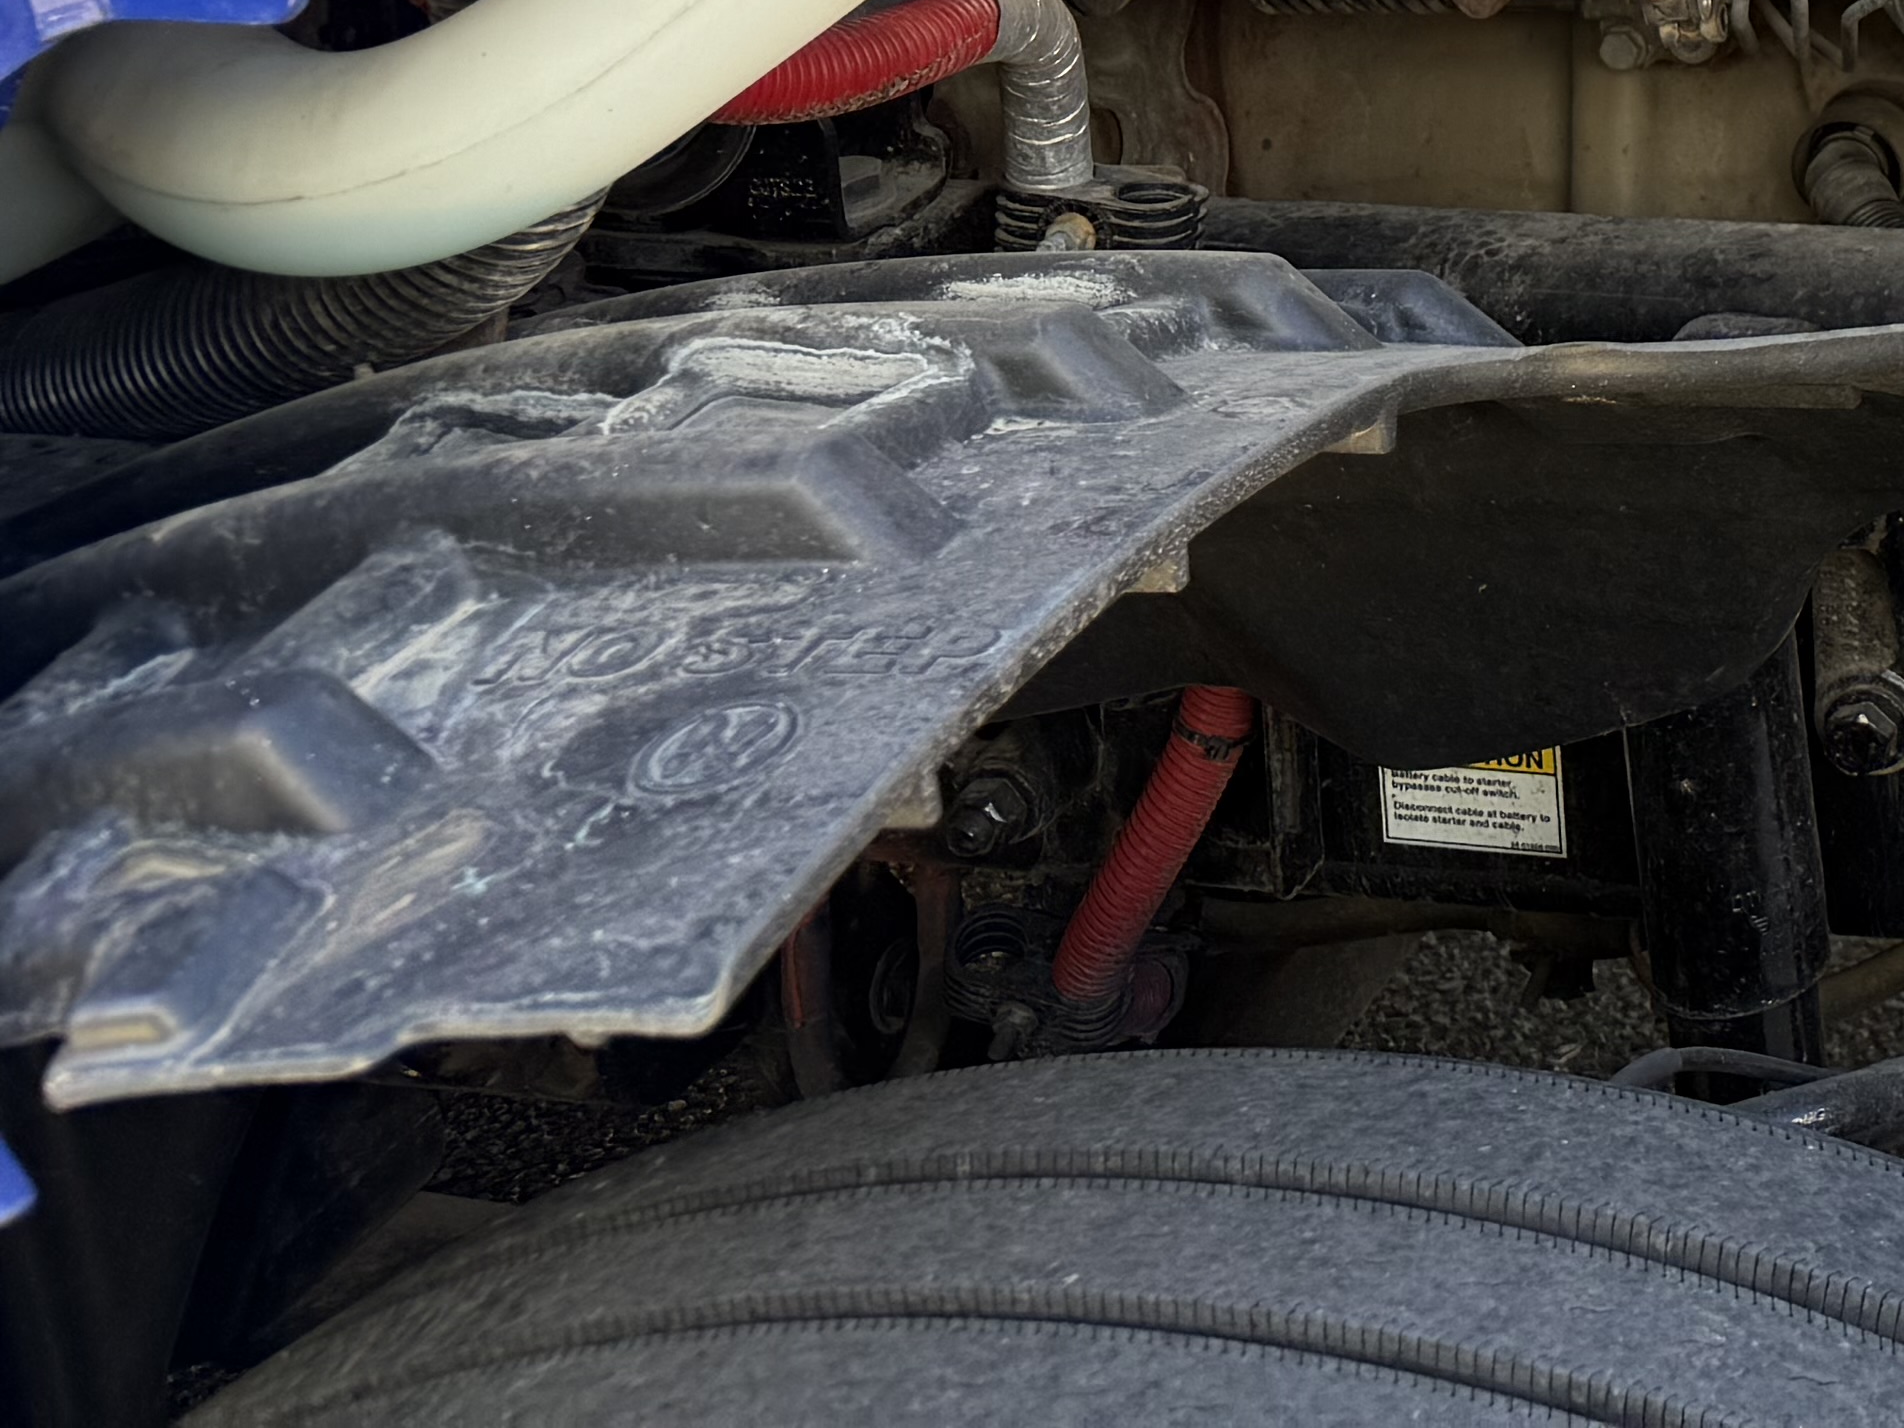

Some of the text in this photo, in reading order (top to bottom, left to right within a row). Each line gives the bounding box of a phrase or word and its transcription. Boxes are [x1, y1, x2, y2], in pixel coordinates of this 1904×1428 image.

[1431, 773, 1461, 784] cable
[1463, 775, 1475, 785] to
[1392, 780, 1442, 793] bypasses
[1483, 789, 1521, 800] switch.
[1394, 801, 1551, 824] Disconnect cable at battery to
[1432, 815, 1466, 827] starter
[1469, 819, 1490, 830] and
